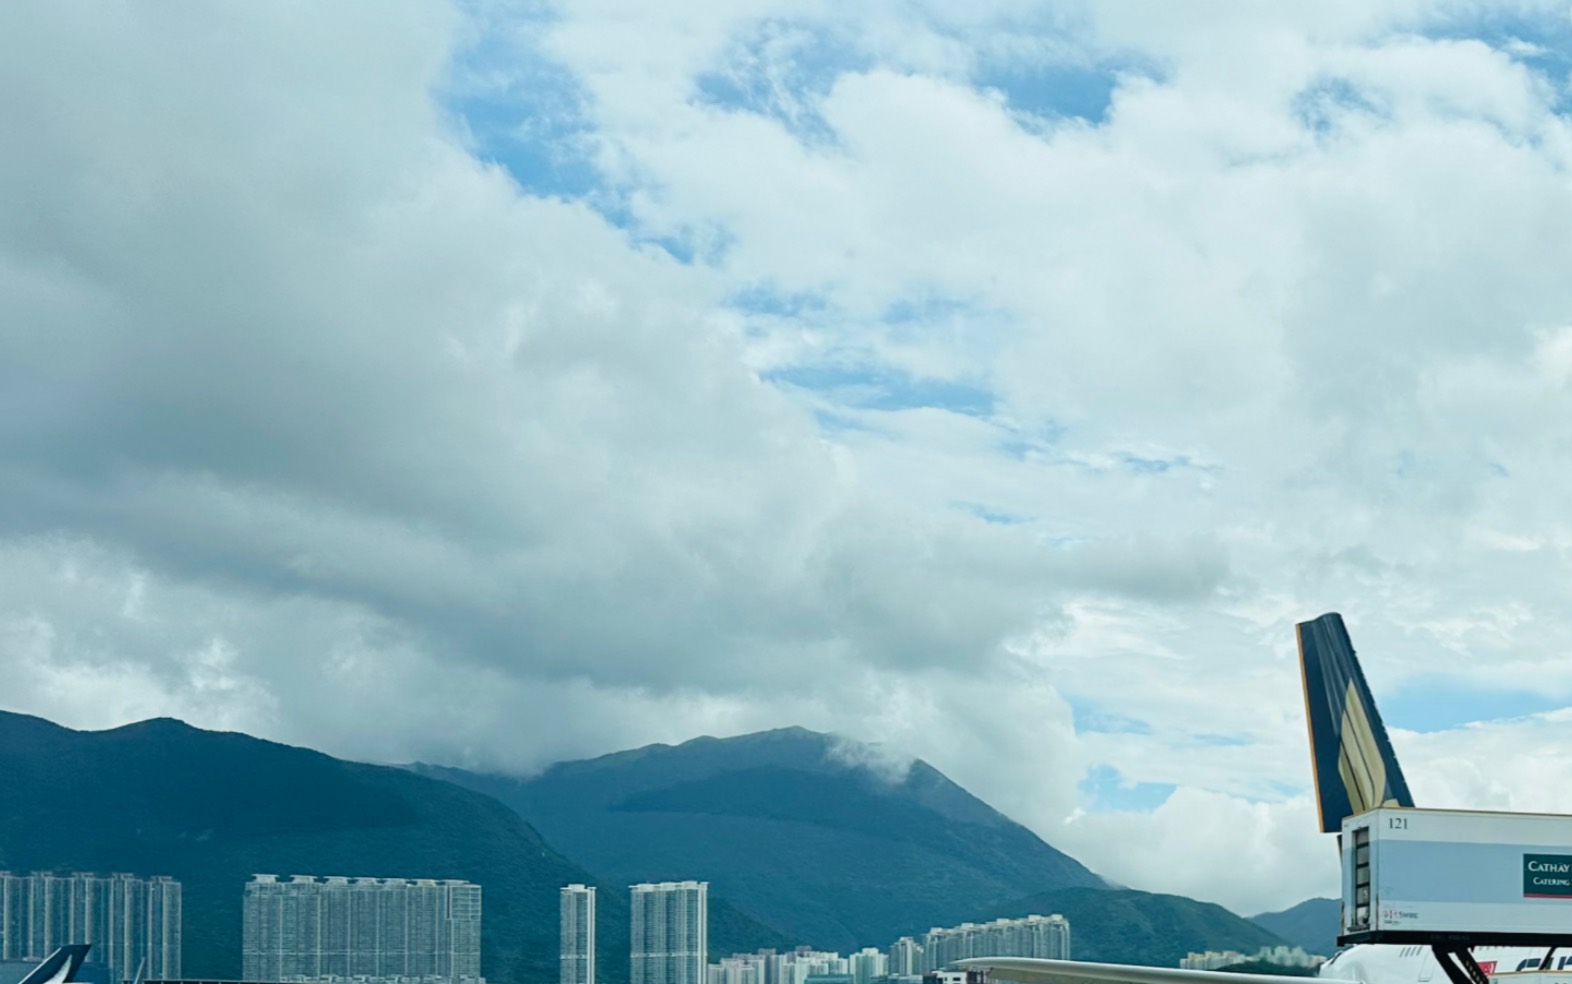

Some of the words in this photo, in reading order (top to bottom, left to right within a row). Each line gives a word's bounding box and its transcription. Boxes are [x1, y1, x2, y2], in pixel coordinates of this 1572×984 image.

[1388, 818, 1408, 830] 121
[1528, 860, 1569, 873] CATHAY
[1533, 877, 1570, 886] CATERING
